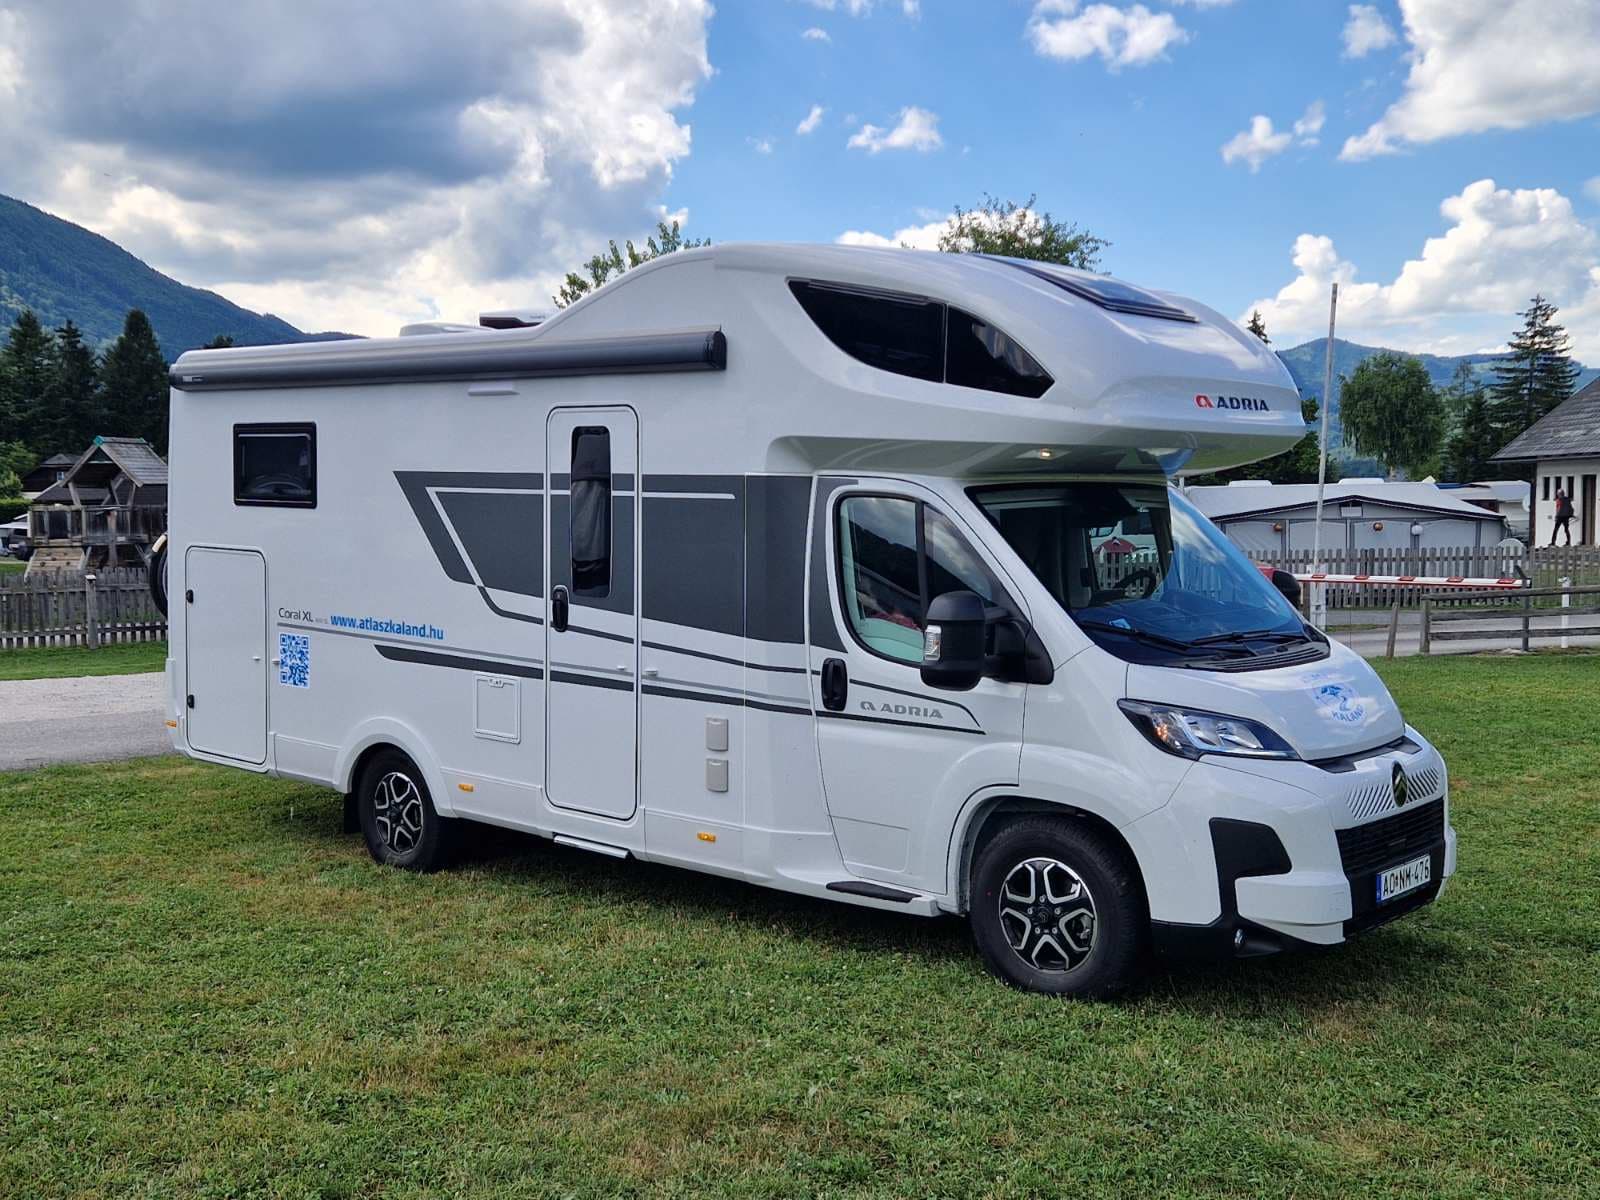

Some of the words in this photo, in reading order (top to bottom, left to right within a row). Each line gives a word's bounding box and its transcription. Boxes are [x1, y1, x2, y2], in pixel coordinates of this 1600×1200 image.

[1217, 396, 1269, 411] ADRIA
[278, 607, 301, 620] Coral
[302, 610, 314, 622] XL
[330, 614, 444, 640] www.atlaszkaland.hu
[880, 703, 943, 719] ADRIA
